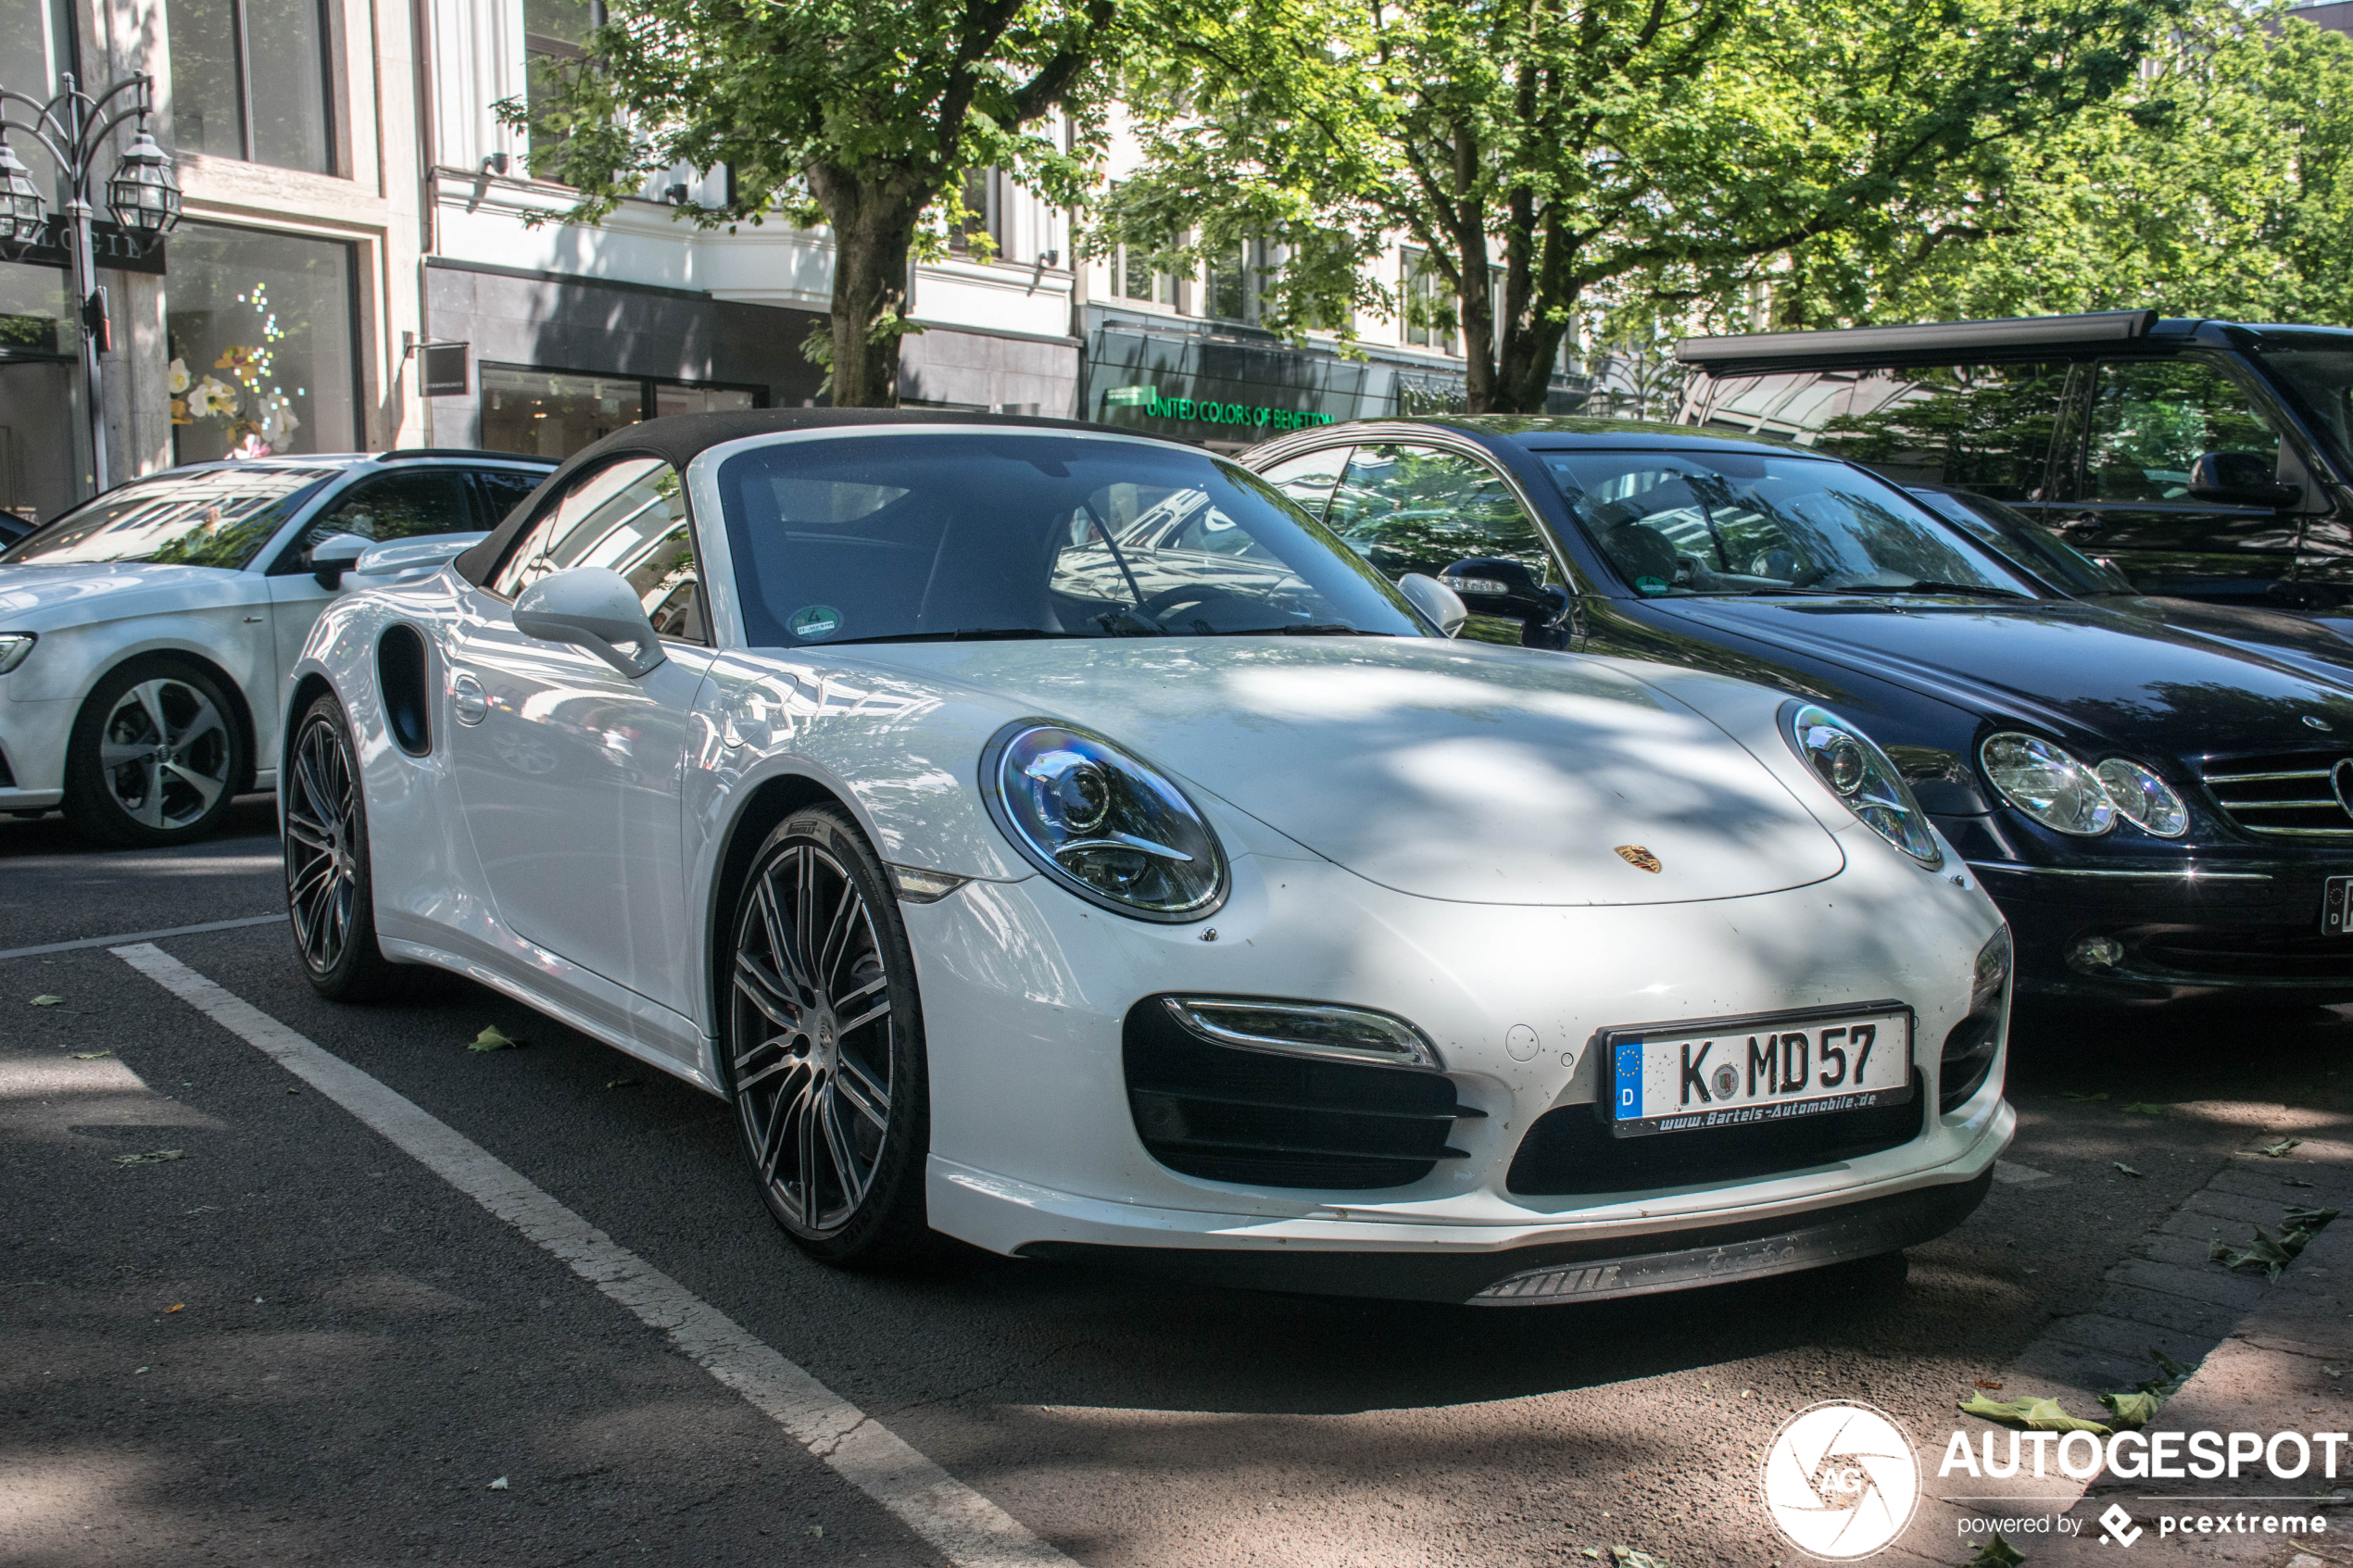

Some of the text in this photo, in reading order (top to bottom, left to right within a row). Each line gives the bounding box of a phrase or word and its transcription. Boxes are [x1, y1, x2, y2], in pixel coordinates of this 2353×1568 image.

[1147, 395, 1197, 420] UNITED
[1200, 401, 1251, 425] COLORS
[1253, 407, 1272, 427] OF
[808, 609, 821, 622] 4
[2331, 913, 2339, 924] D
[1680, 1023, 1877, 1106] K MD 57
[1622, 1088, 1634, 1107] D
[1659, 1093, 1878, 1132] www.Bartels-Automobile.de
[1706, 1243, 1795, 1273] turbo
